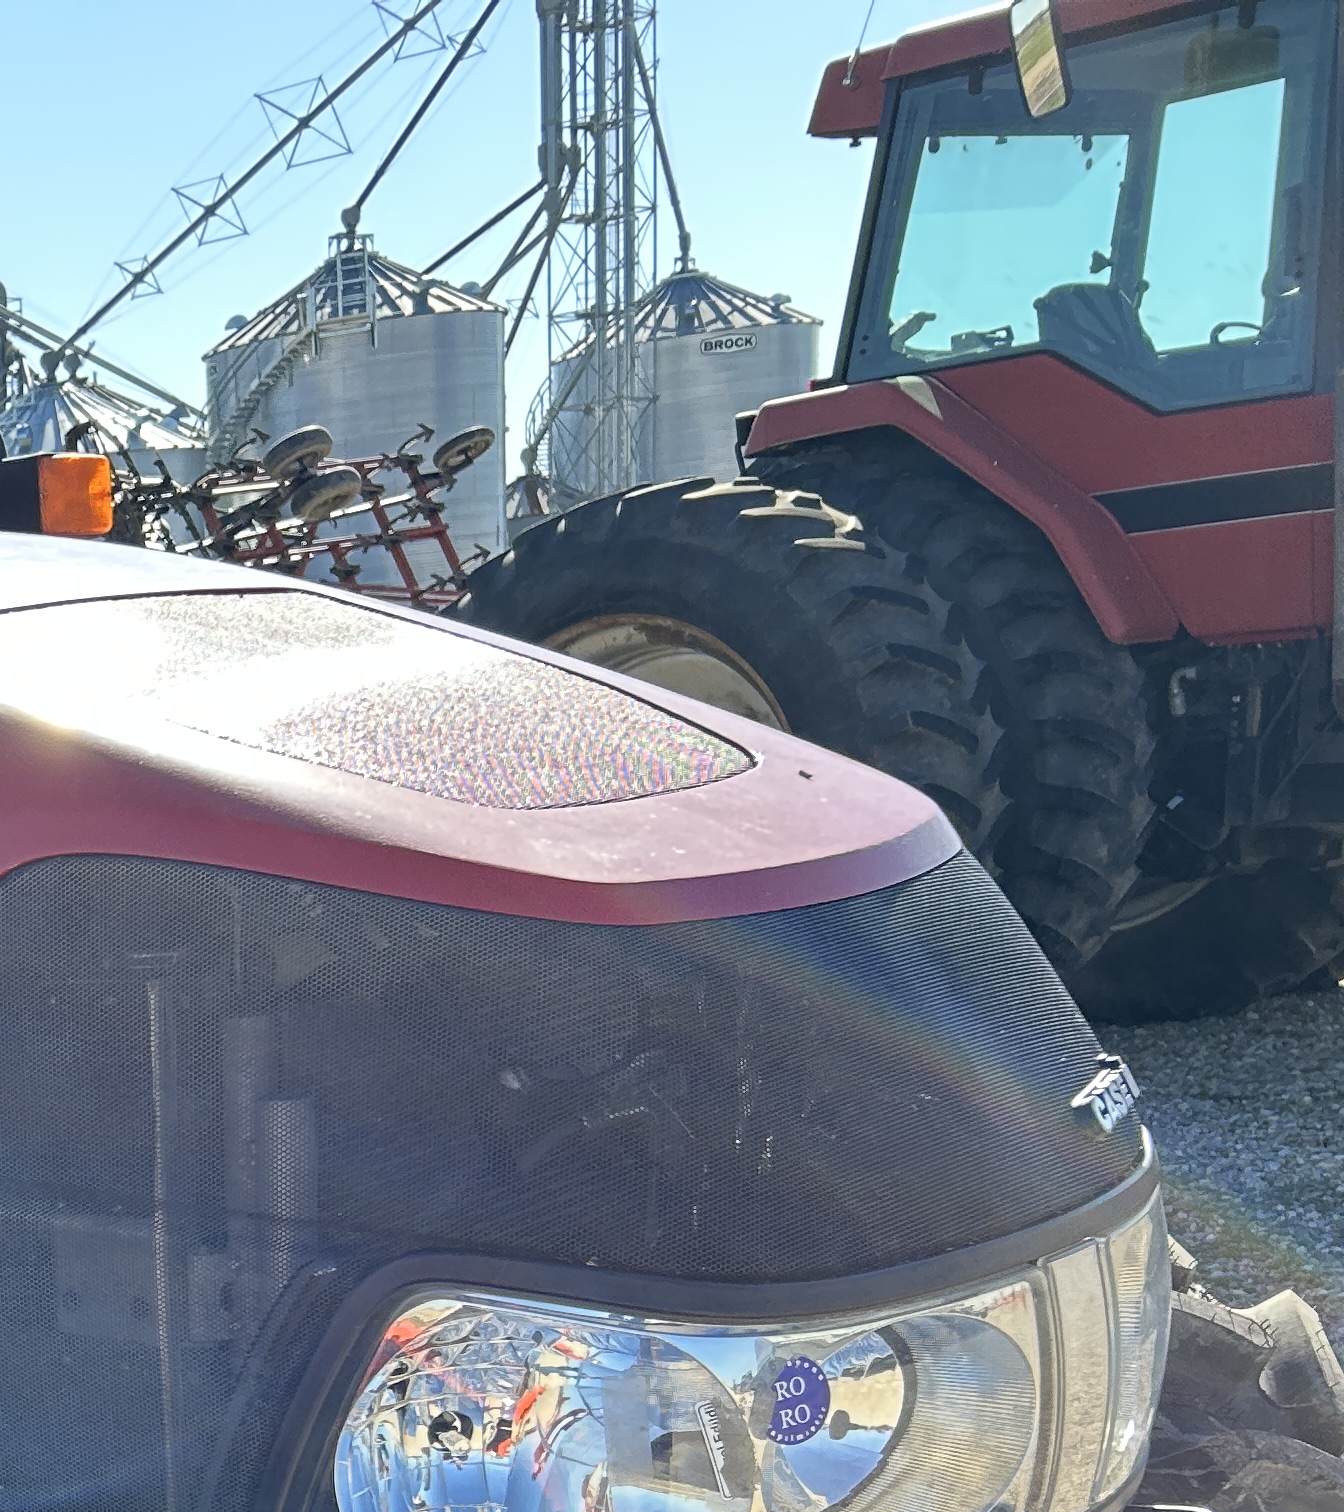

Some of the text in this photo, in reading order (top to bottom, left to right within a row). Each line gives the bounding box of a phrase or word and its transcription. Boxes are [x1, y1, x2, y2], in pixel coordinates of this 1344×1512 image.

[703, 335, 754, 352] BROCK
[773, 1375, 806, 1402] RO
[778, 1403, 811, 1429] RO
